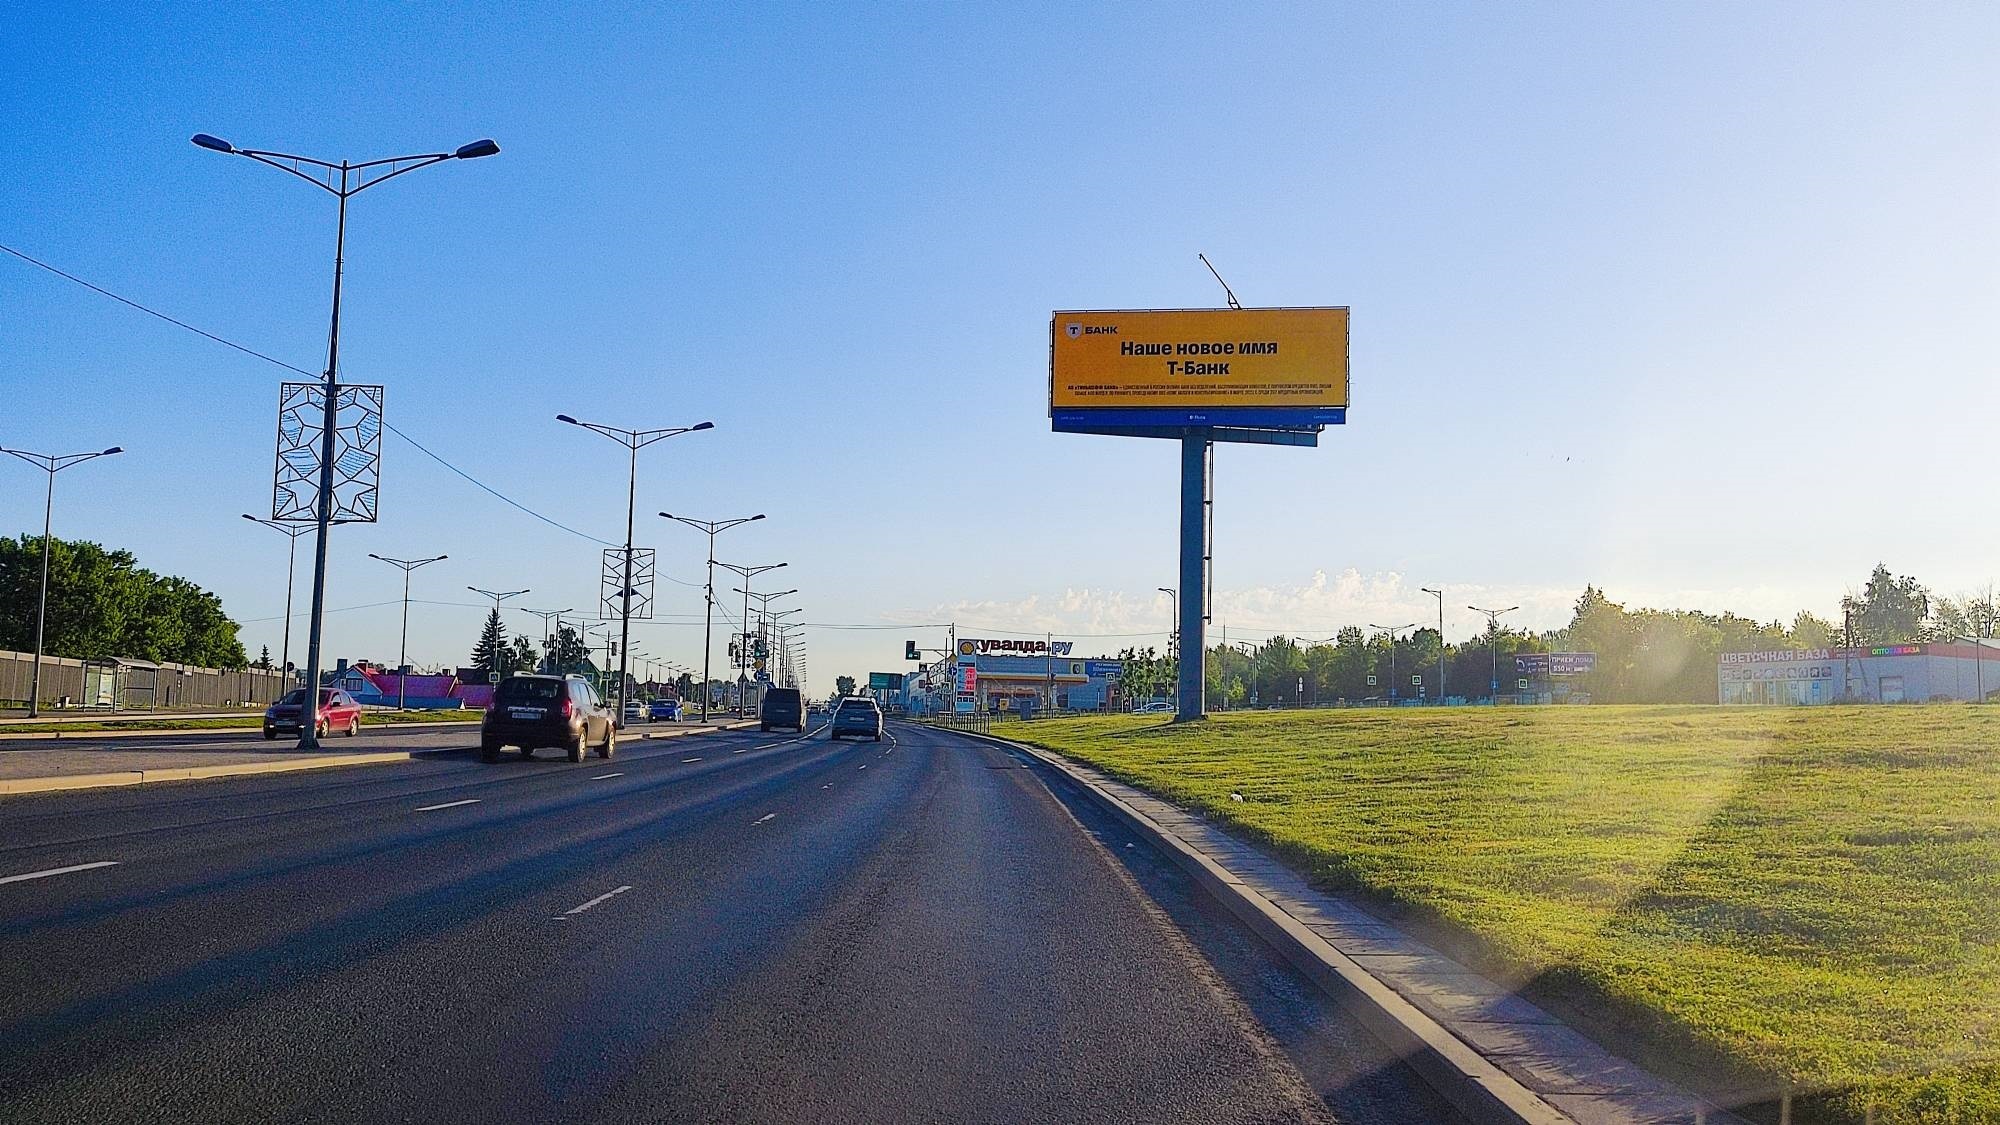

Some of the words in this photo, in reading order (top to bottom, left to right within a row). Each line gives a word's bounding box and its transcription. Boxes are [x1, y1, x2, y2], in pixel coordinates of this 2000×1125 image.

[1085, 326, 1118, 335] БАНК
[1121, 341, 1172, 356] Наше
[1176, 343, 1235, 355] новое
[1238, 342, 1278, 355] имя
[1166, 360, 1230, 376] Т-Банк
[1721, 650, 1793, 664] ЦВЕТОЧНАЯ
[1797, 648, 1830, 660] БАЗА
